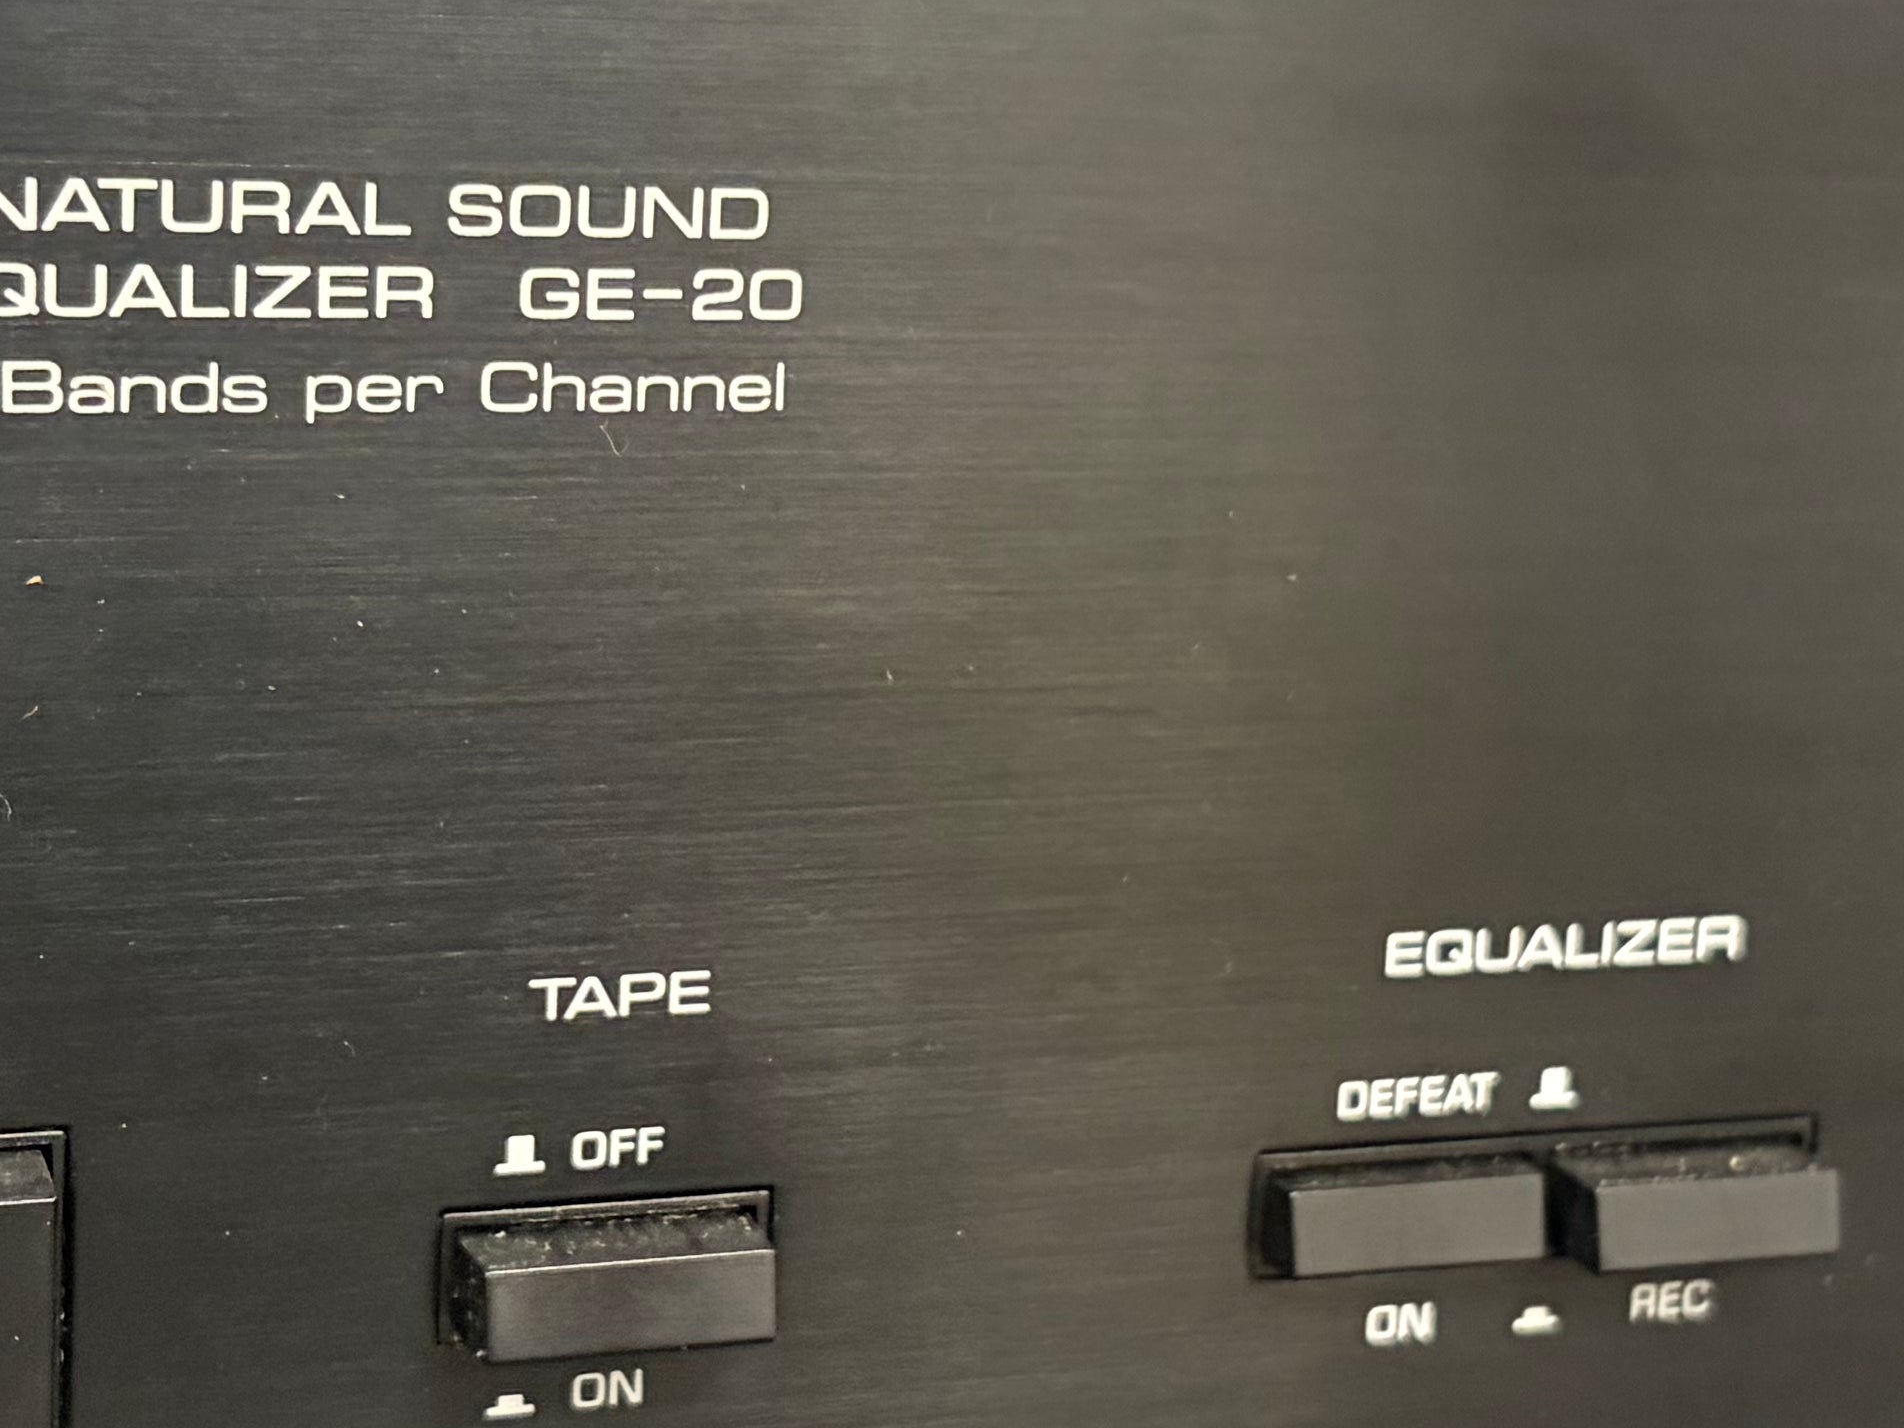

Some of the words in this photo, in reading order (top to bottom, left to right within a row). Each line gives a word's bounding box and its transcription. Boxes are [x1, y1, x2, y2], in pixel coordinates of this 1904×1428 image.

[446, 182, 770, 241] SOUND
[518, 266, 804, 322] GE-20
[0, 359, 269, 415] Bands
[304, 373, 445, 425] per
[479, 360, 787, 414] Channel
[1383, 914, 1747, 978] EQUALIZER
[526, 968, 713, 1023] TAPE
[1336, 1071, 1499, 1121] DEFEAT
[570, 1125, 667, 1171] OFF
[1365, 1301, 1436, 1346] ON
[1629, 1279, 1712, 1322] REC
[571, 1368, 644, 1410] ON
